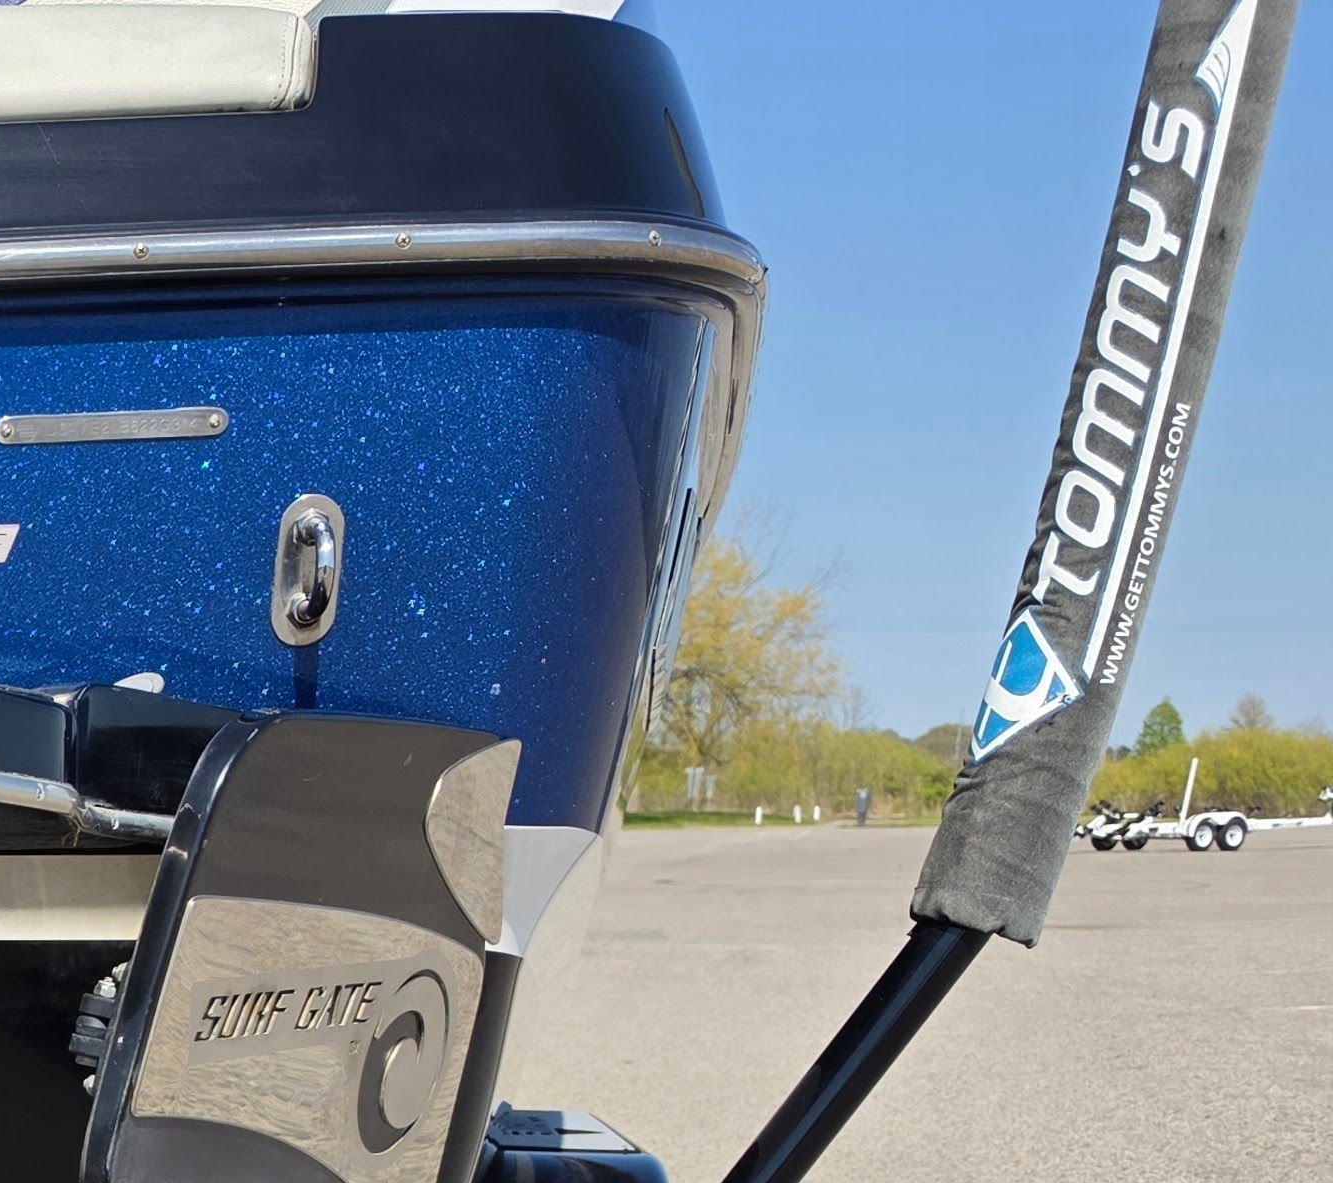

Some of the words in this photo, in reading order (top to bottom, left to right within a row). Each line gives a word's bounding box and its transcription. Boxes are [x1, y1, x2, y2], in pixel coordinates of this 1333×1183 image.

[1099, 402, 1191, 685] WWW.GETTOMMYS.COM
[193, 988, 295, 1042] SURF
[293, 980, 383, 1033] GATE
